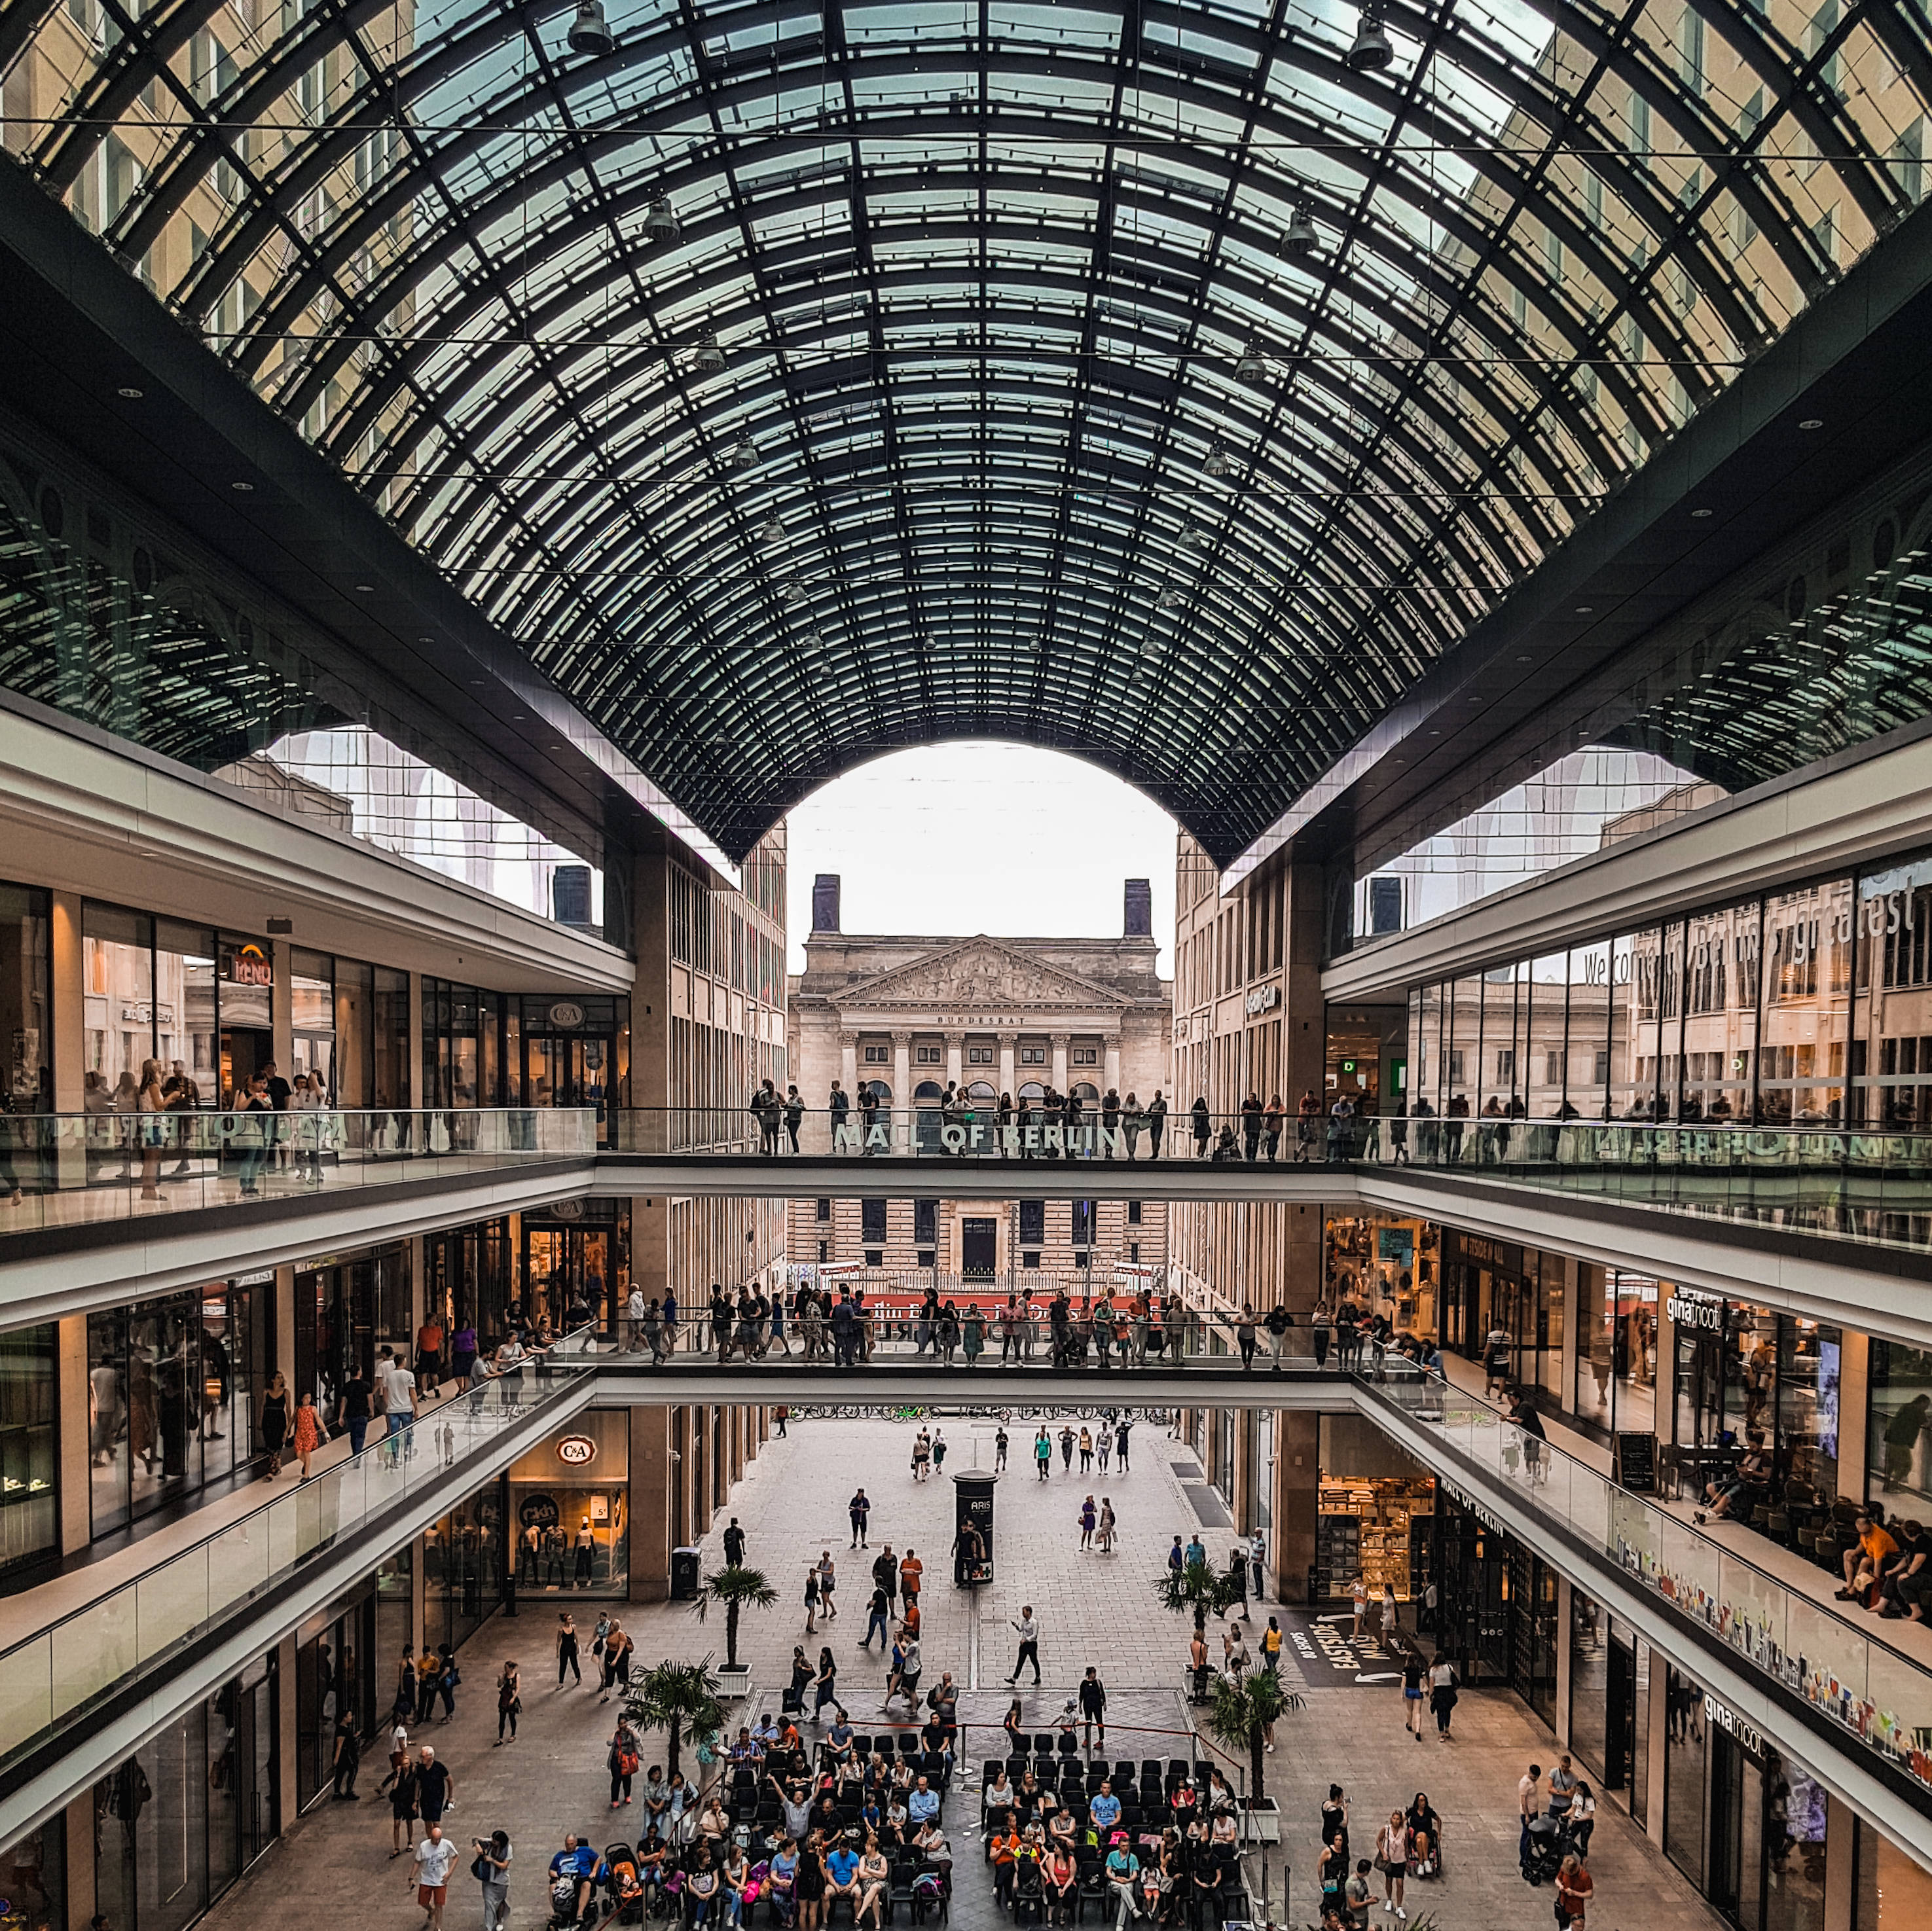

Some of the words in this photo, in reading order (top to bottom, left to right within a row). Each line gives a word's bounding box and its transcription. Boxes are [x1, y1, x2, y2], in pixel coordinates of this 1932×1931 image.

[1584, 947, 1656, 986] Wecome
[554, 1007, 578, 1021] C&A
[1344, 1062, 1353, 1072] D
[833, 1123, 924, 1147] MALL
[941, 1123, 985, 1149] OF
[1002, 1125, 1121, 1149] BERLIN
[564, 1445, 587, 1457] C&A
[1441, 1477, 1460, 1502] MALL
[971, 1500, 991, 1509] ARIS
[1290, 1632, 1313, 1651] SHOPS
[1308, 1623, 1362, 1669] EASTSIDE
[1300, 1651, 1318, 1659] 80
